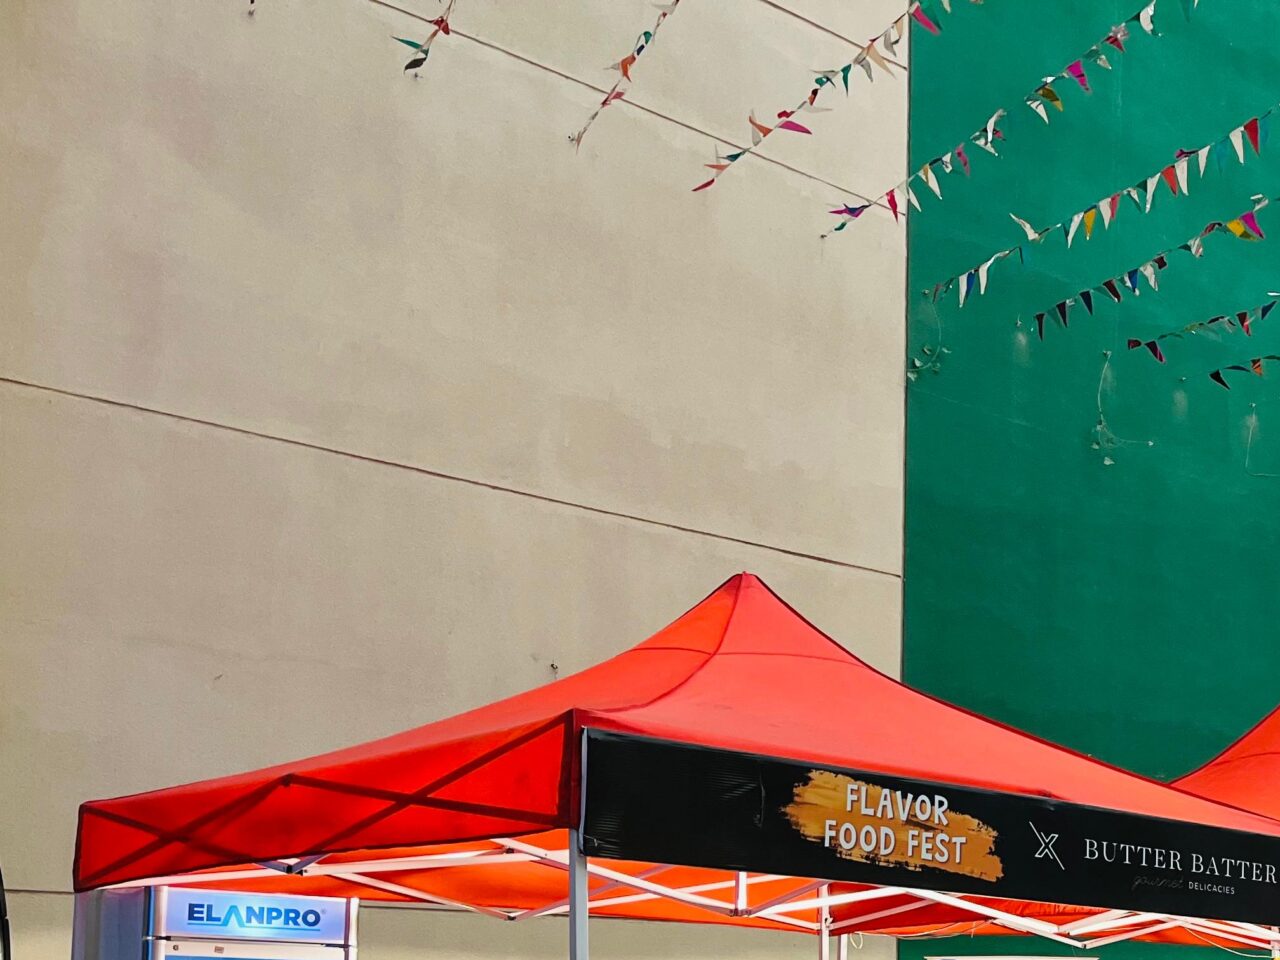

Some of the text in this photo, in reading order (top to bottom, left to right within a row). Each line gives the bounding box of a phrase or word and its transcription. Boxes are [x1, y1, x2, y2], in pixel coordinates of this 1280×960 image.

[845, 783, 949, 826] FLAVOR
[824, 819, 966, 864] FOOD FEST
[1084, 838, 1278, 885] BUTTER BATTER
[1188, 881, 1236, 895] DELICACIES
[187, 902, 322, 929] ELANPRO
